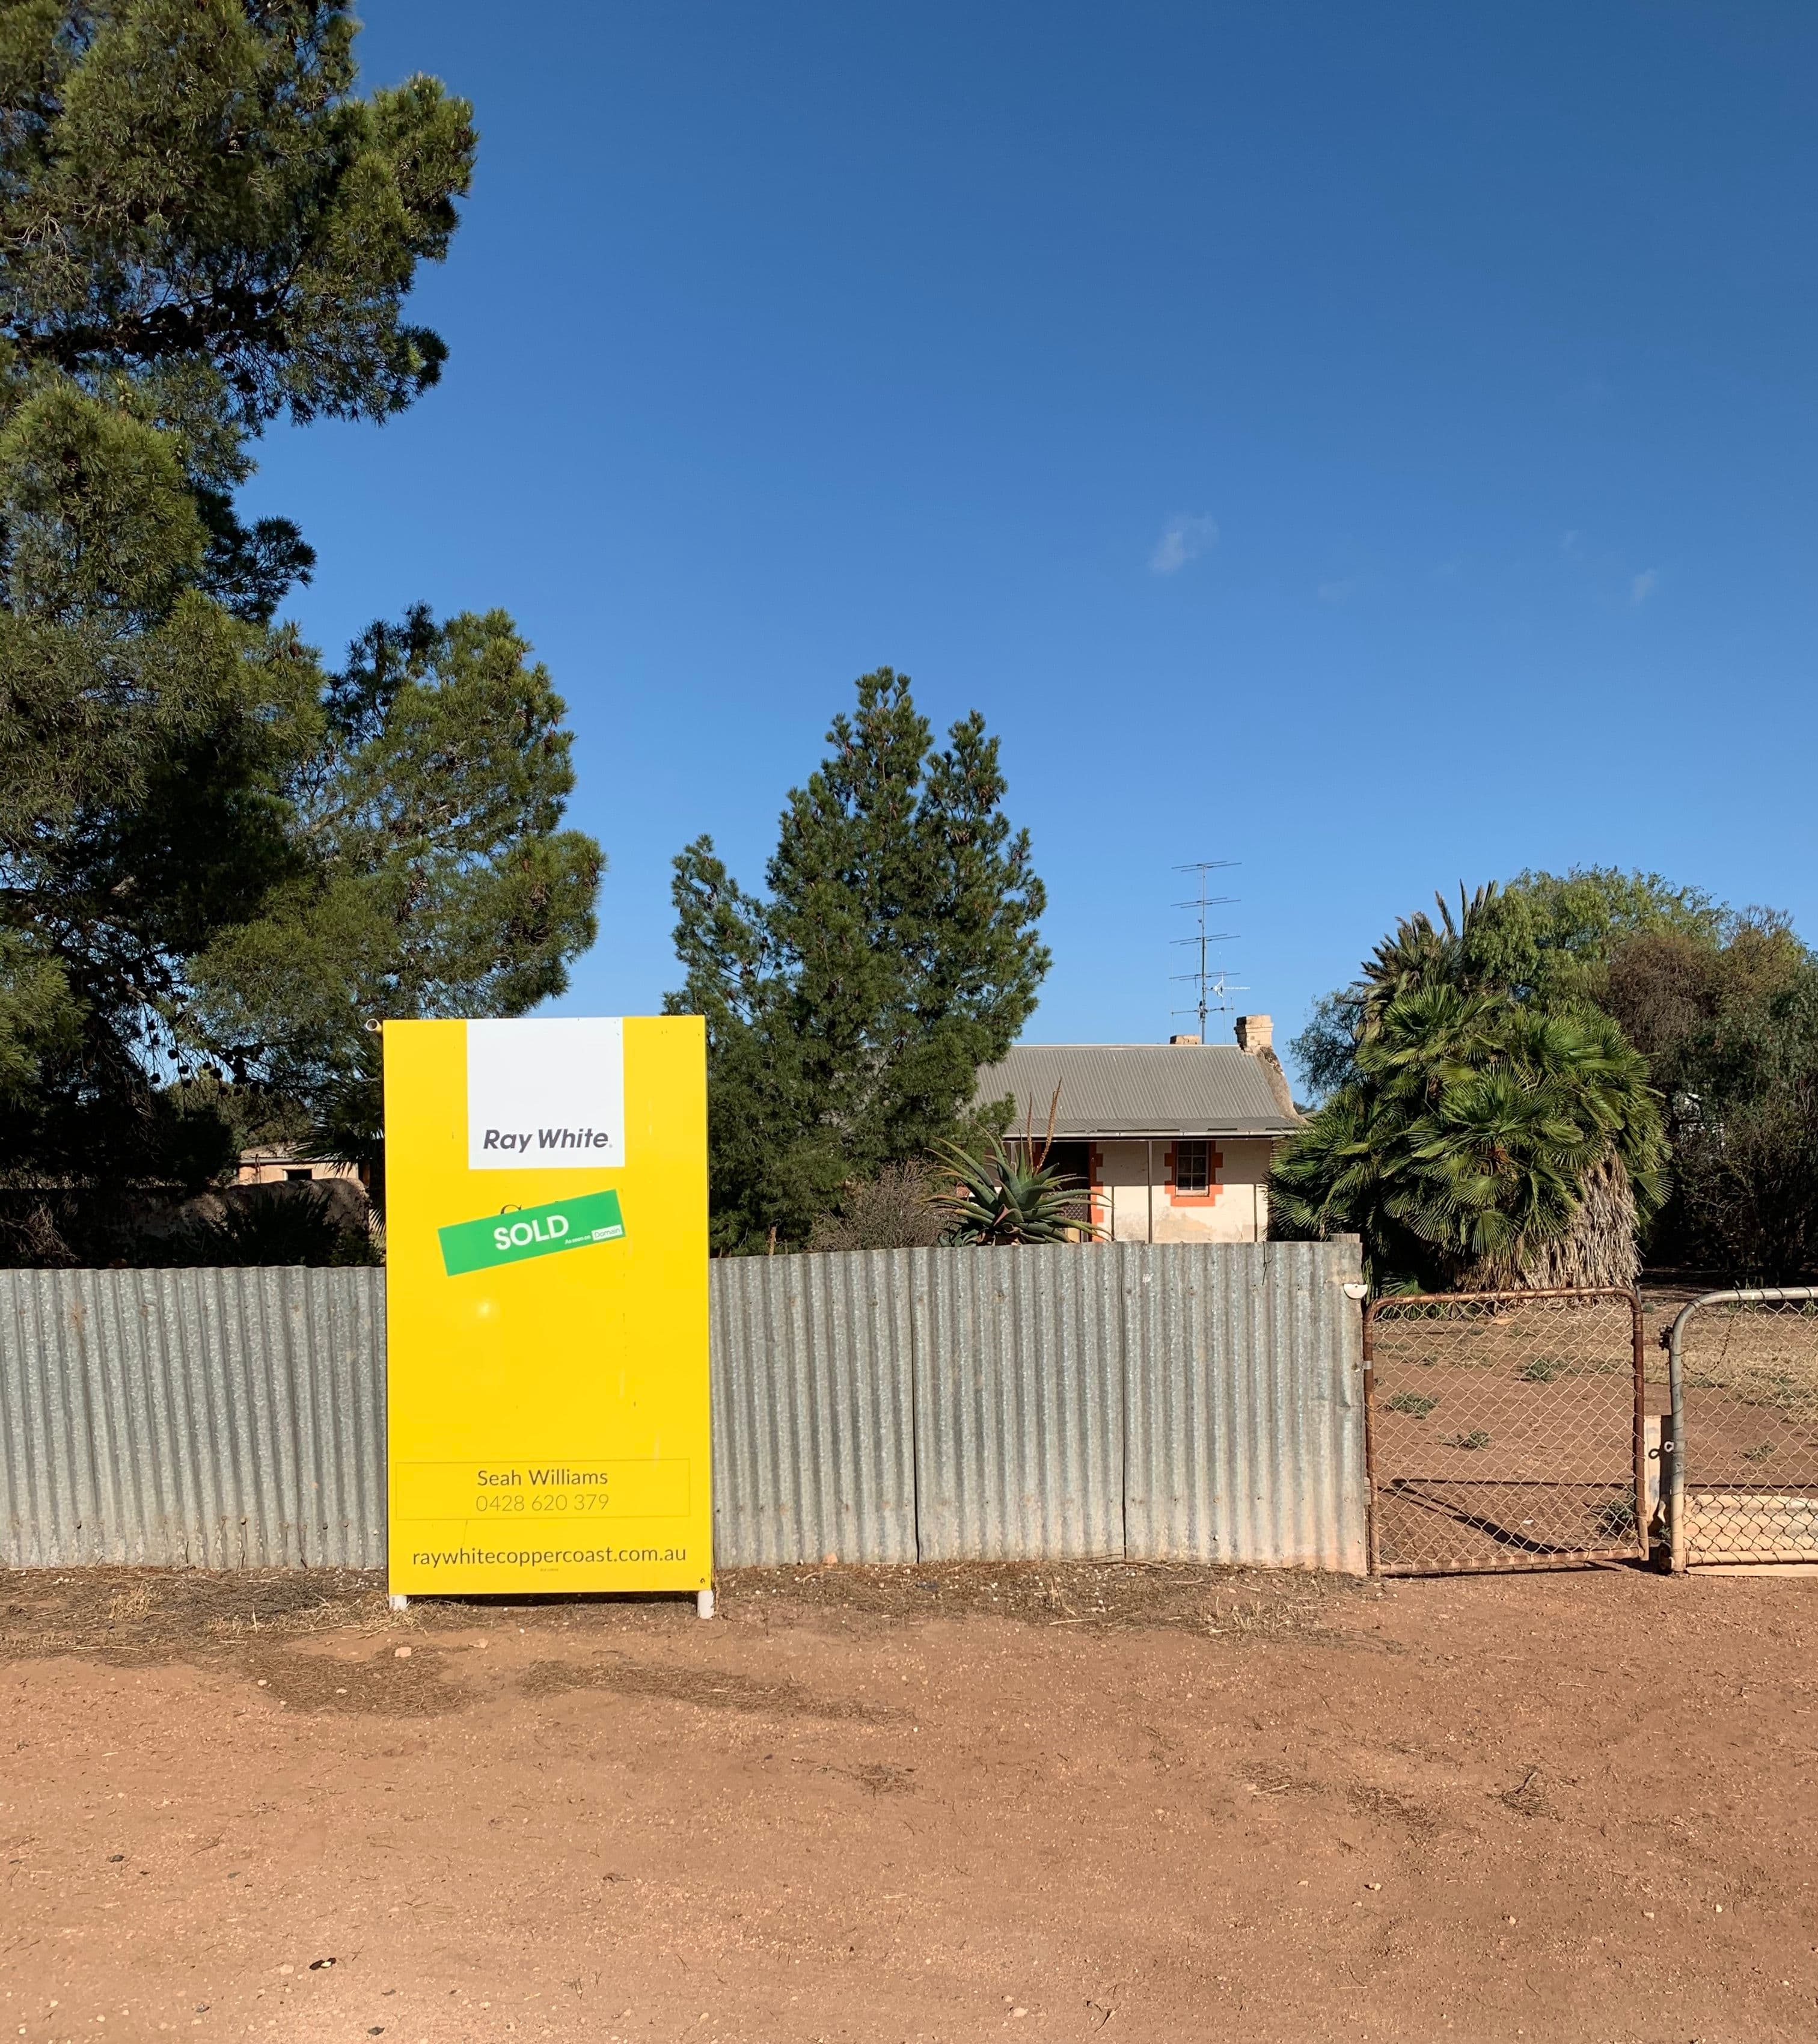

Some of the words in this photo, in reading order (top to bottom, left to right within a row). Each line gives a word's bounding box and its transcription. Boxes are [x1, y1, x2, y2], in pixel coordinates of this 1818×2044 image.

[483, 1129, 533, 1153] Ray
[493, 1214, 569, 1250] SOLD
[594, 1228, 620, 1238] Domain
[477, 1469, 521, 1487] Seah
[528, 1469, 608, 1486] Williams
[476, 1495, 525, 1512] 0428
[531, 1494, 568, 1511] 620
[574, 1493, 609, 1511] 379
[413, 1546, 686, 1568] raywhitecoppercoast.com.au
